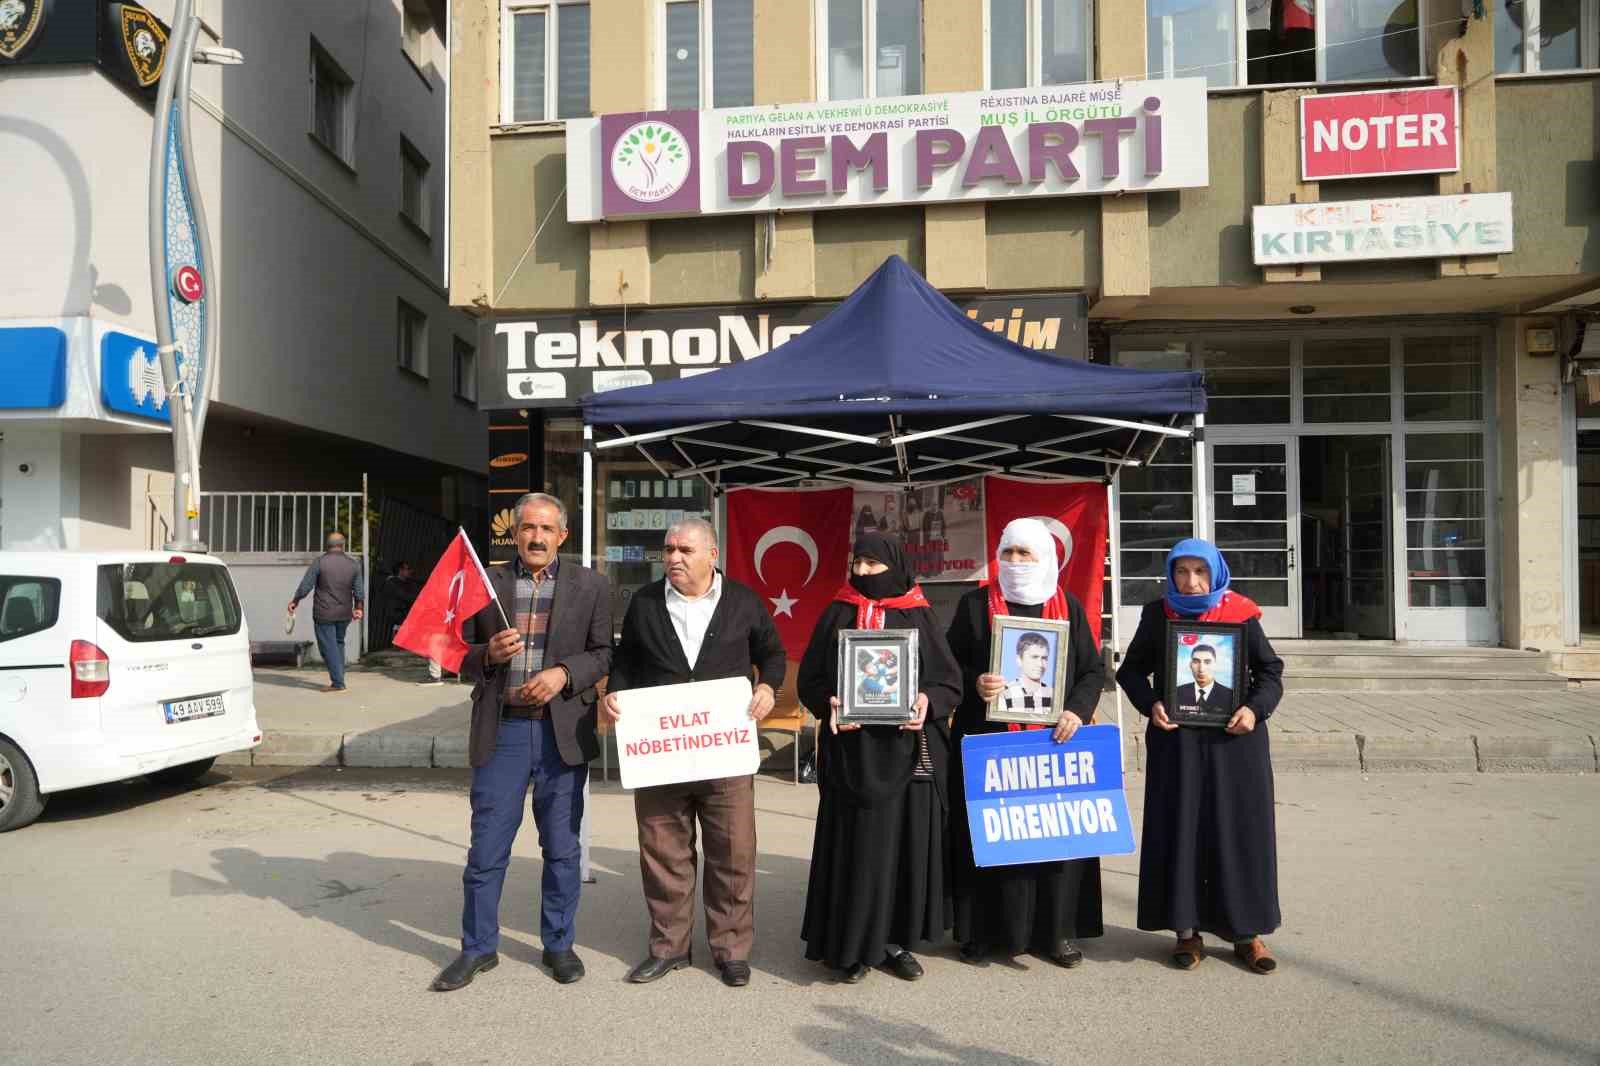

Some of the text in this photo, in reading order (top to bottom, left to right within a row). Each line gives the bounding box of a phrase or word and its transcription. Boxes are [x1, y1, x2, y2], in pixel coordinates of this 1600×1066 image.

[727, 114, 949, 139] HALKLARIN EŞİTLİK VE DEMOKRASİ PARTİSİ
[768, 110, 803, 122] GELAN
[980, 112, 1018, 128] MUŞ
[1046, 103, 1123, 121] ÖRGÜTÜ
[1312, 113, 1449, 153] NOTER
[727, 96, 1162, 200] DEM PARTİ
[1261, 220, 1505, 256] KIRTASİYE
[173, 704, 185, 716] 49
[659, 711, 711, 730] EVLAT
[625, 728, 751, 757] NÖBETİNDEYİZ
[984, 751, 1096, 793] ANNELER
[982, 792, 1118, 843] DİRENİYOR
